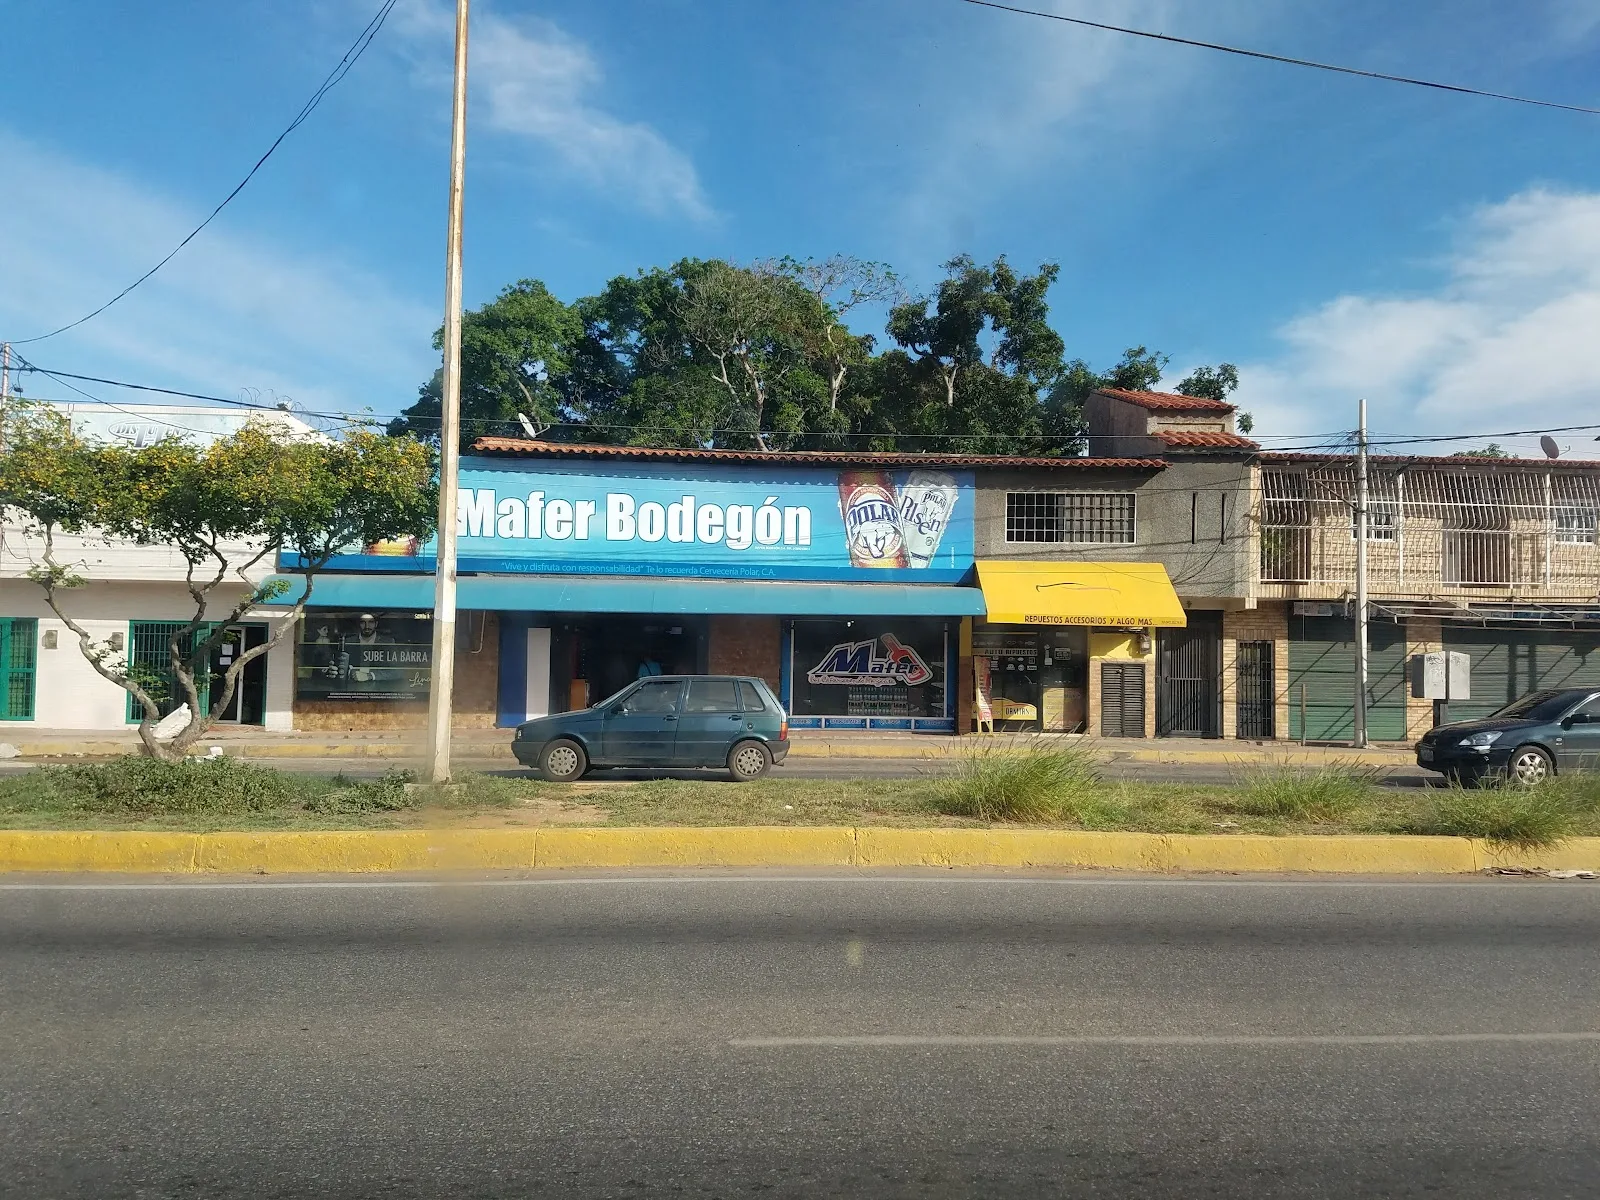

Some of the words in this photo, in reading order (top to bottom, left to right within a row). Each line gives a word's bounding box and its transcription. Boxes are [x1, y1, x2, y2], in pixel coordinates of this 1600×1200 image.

[457, 488, 597, 541] Mafer
[605, 492, 812, 551] Bodegón
[900, 495, 941, 535] Pilsen
[530, 563, 560, 572] disfruta
[646, 565, 656, 573] Te
[656, 565, 664, 573] lo
[664, 566, 698, 575] recuerda
[740, 567, 761, 577] Polar,
[761, 568, 777, 576] C.A.
[1024, 615, 1063, 624] REPUESTOS
[1064, 616, 1107, 624] ACCESORIOS
[1116, 617, 1136, 625] ALGO
[363, 650, 385, 663] SUBE
[386, 651, 398, 663] LA
[400, 651, 428, 663] BARRA
[820, 643, 922, 674] Mafer
